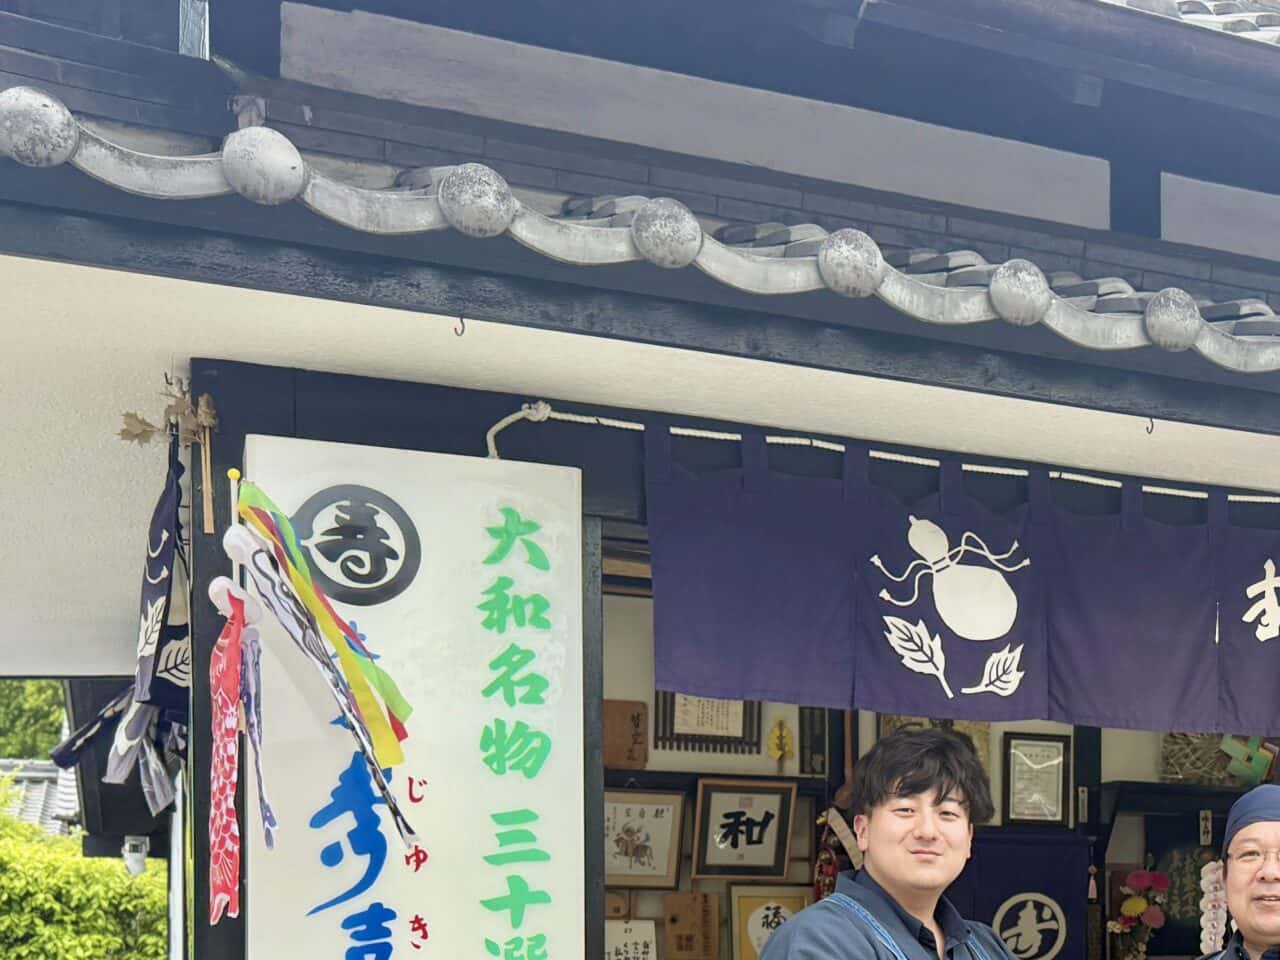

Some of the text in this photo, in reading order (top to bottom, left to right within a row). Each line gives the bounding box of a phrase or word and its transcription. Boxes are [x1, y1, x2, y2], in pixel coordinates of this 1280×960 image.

[477, 506, 553, 780] 大和名物
[719, 810, 775, 849] 和
